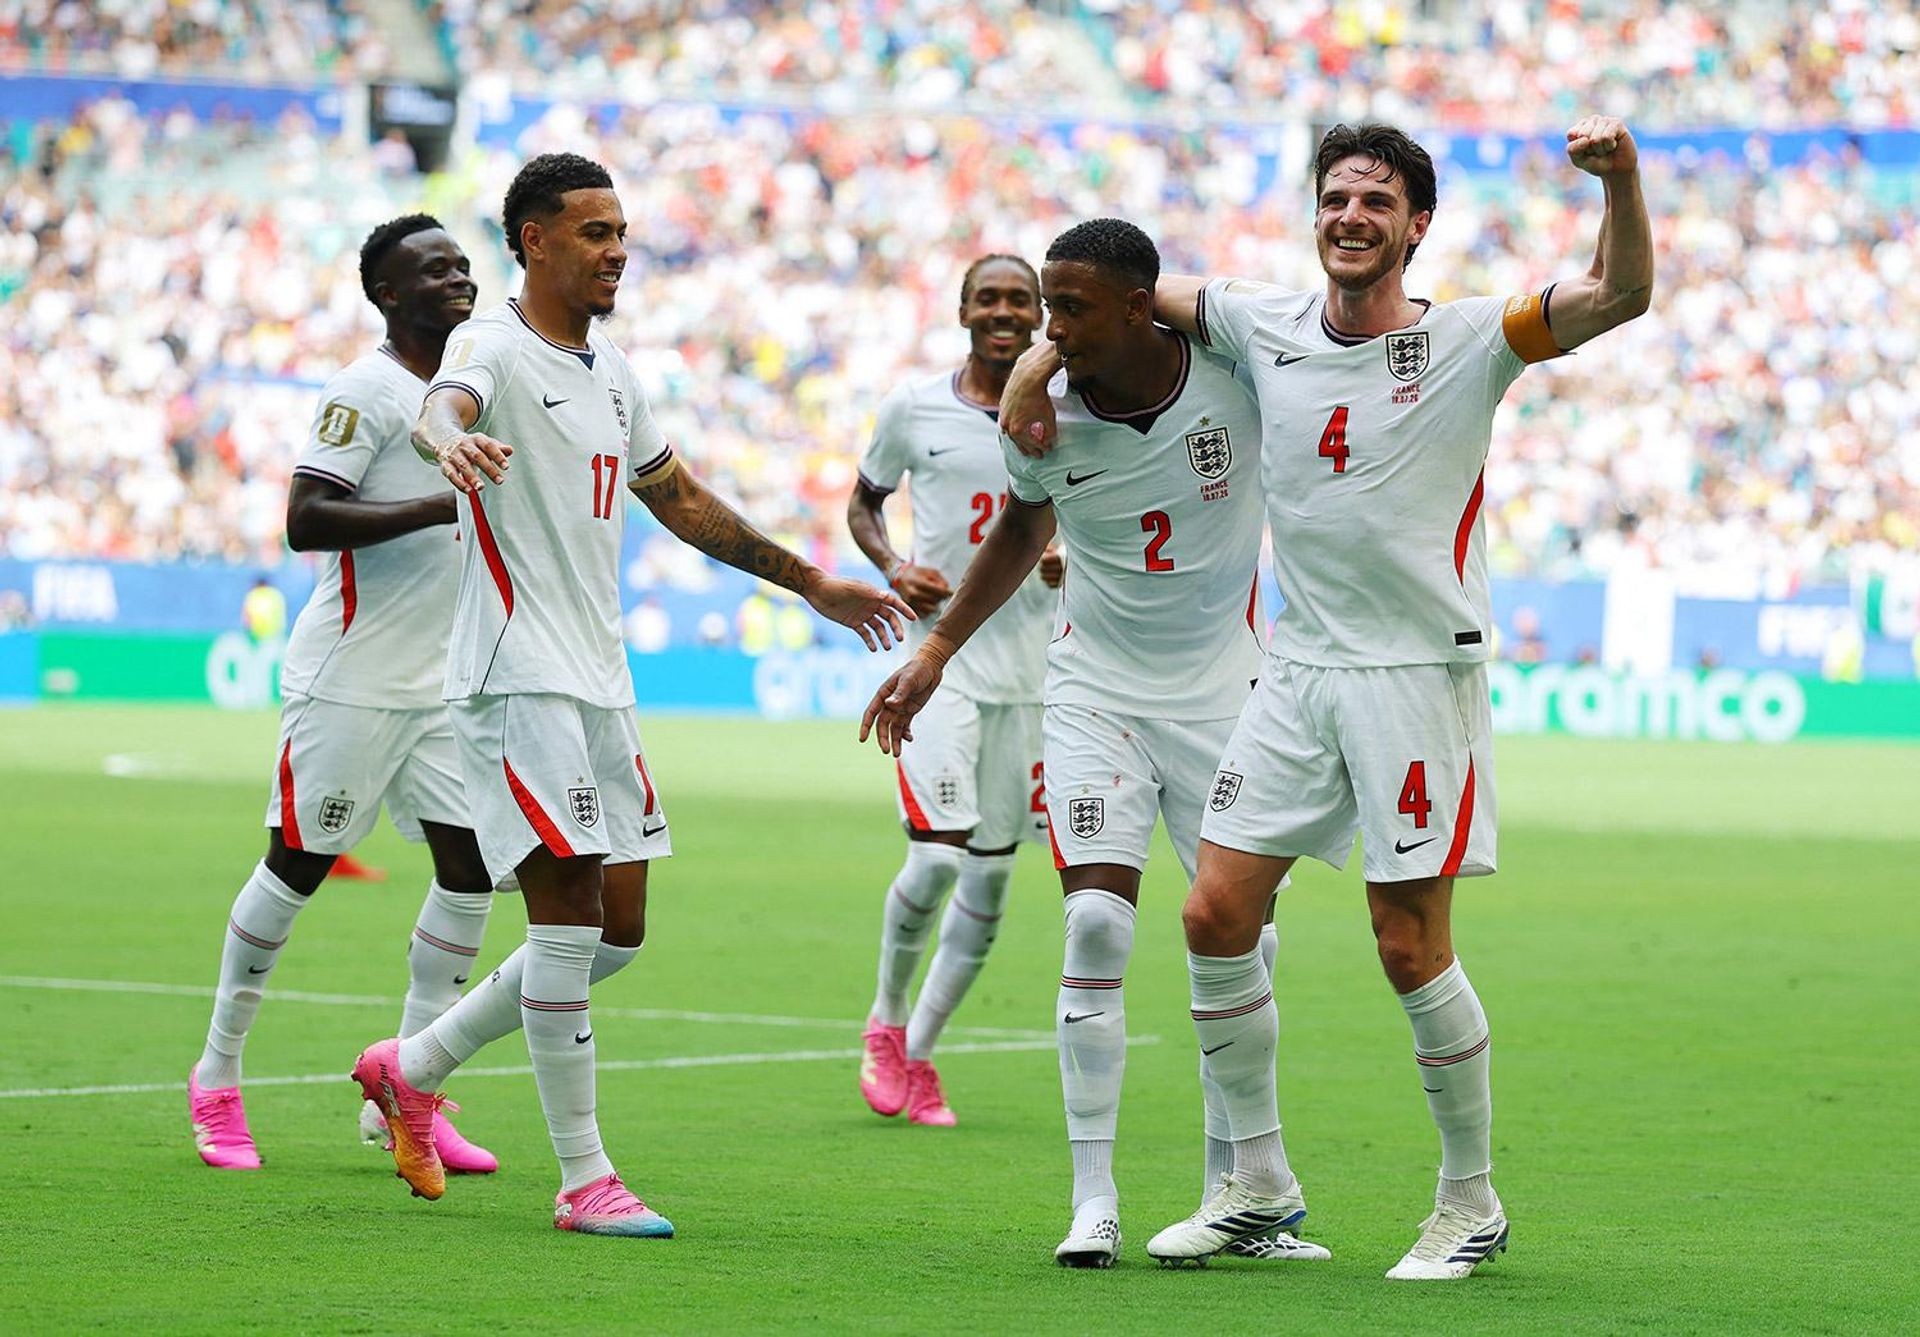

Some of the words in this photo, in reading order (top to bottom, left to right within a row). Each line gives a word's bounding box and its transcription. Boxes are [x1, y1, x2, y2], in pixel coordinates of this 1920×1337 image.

[1391, 383, 1420, 394] FRANCE
[1318, 406, 1350, 473] 4
[591, 453, 619, 520] 17
[969, 492, 1007, 544] 2
[1200, 480, 1229, 494] FRANCE
[1140, 510, 1174, 571] 2
[1485, 662, 1806, 743] aramco
[1398, 761, 1432, 829] 4
